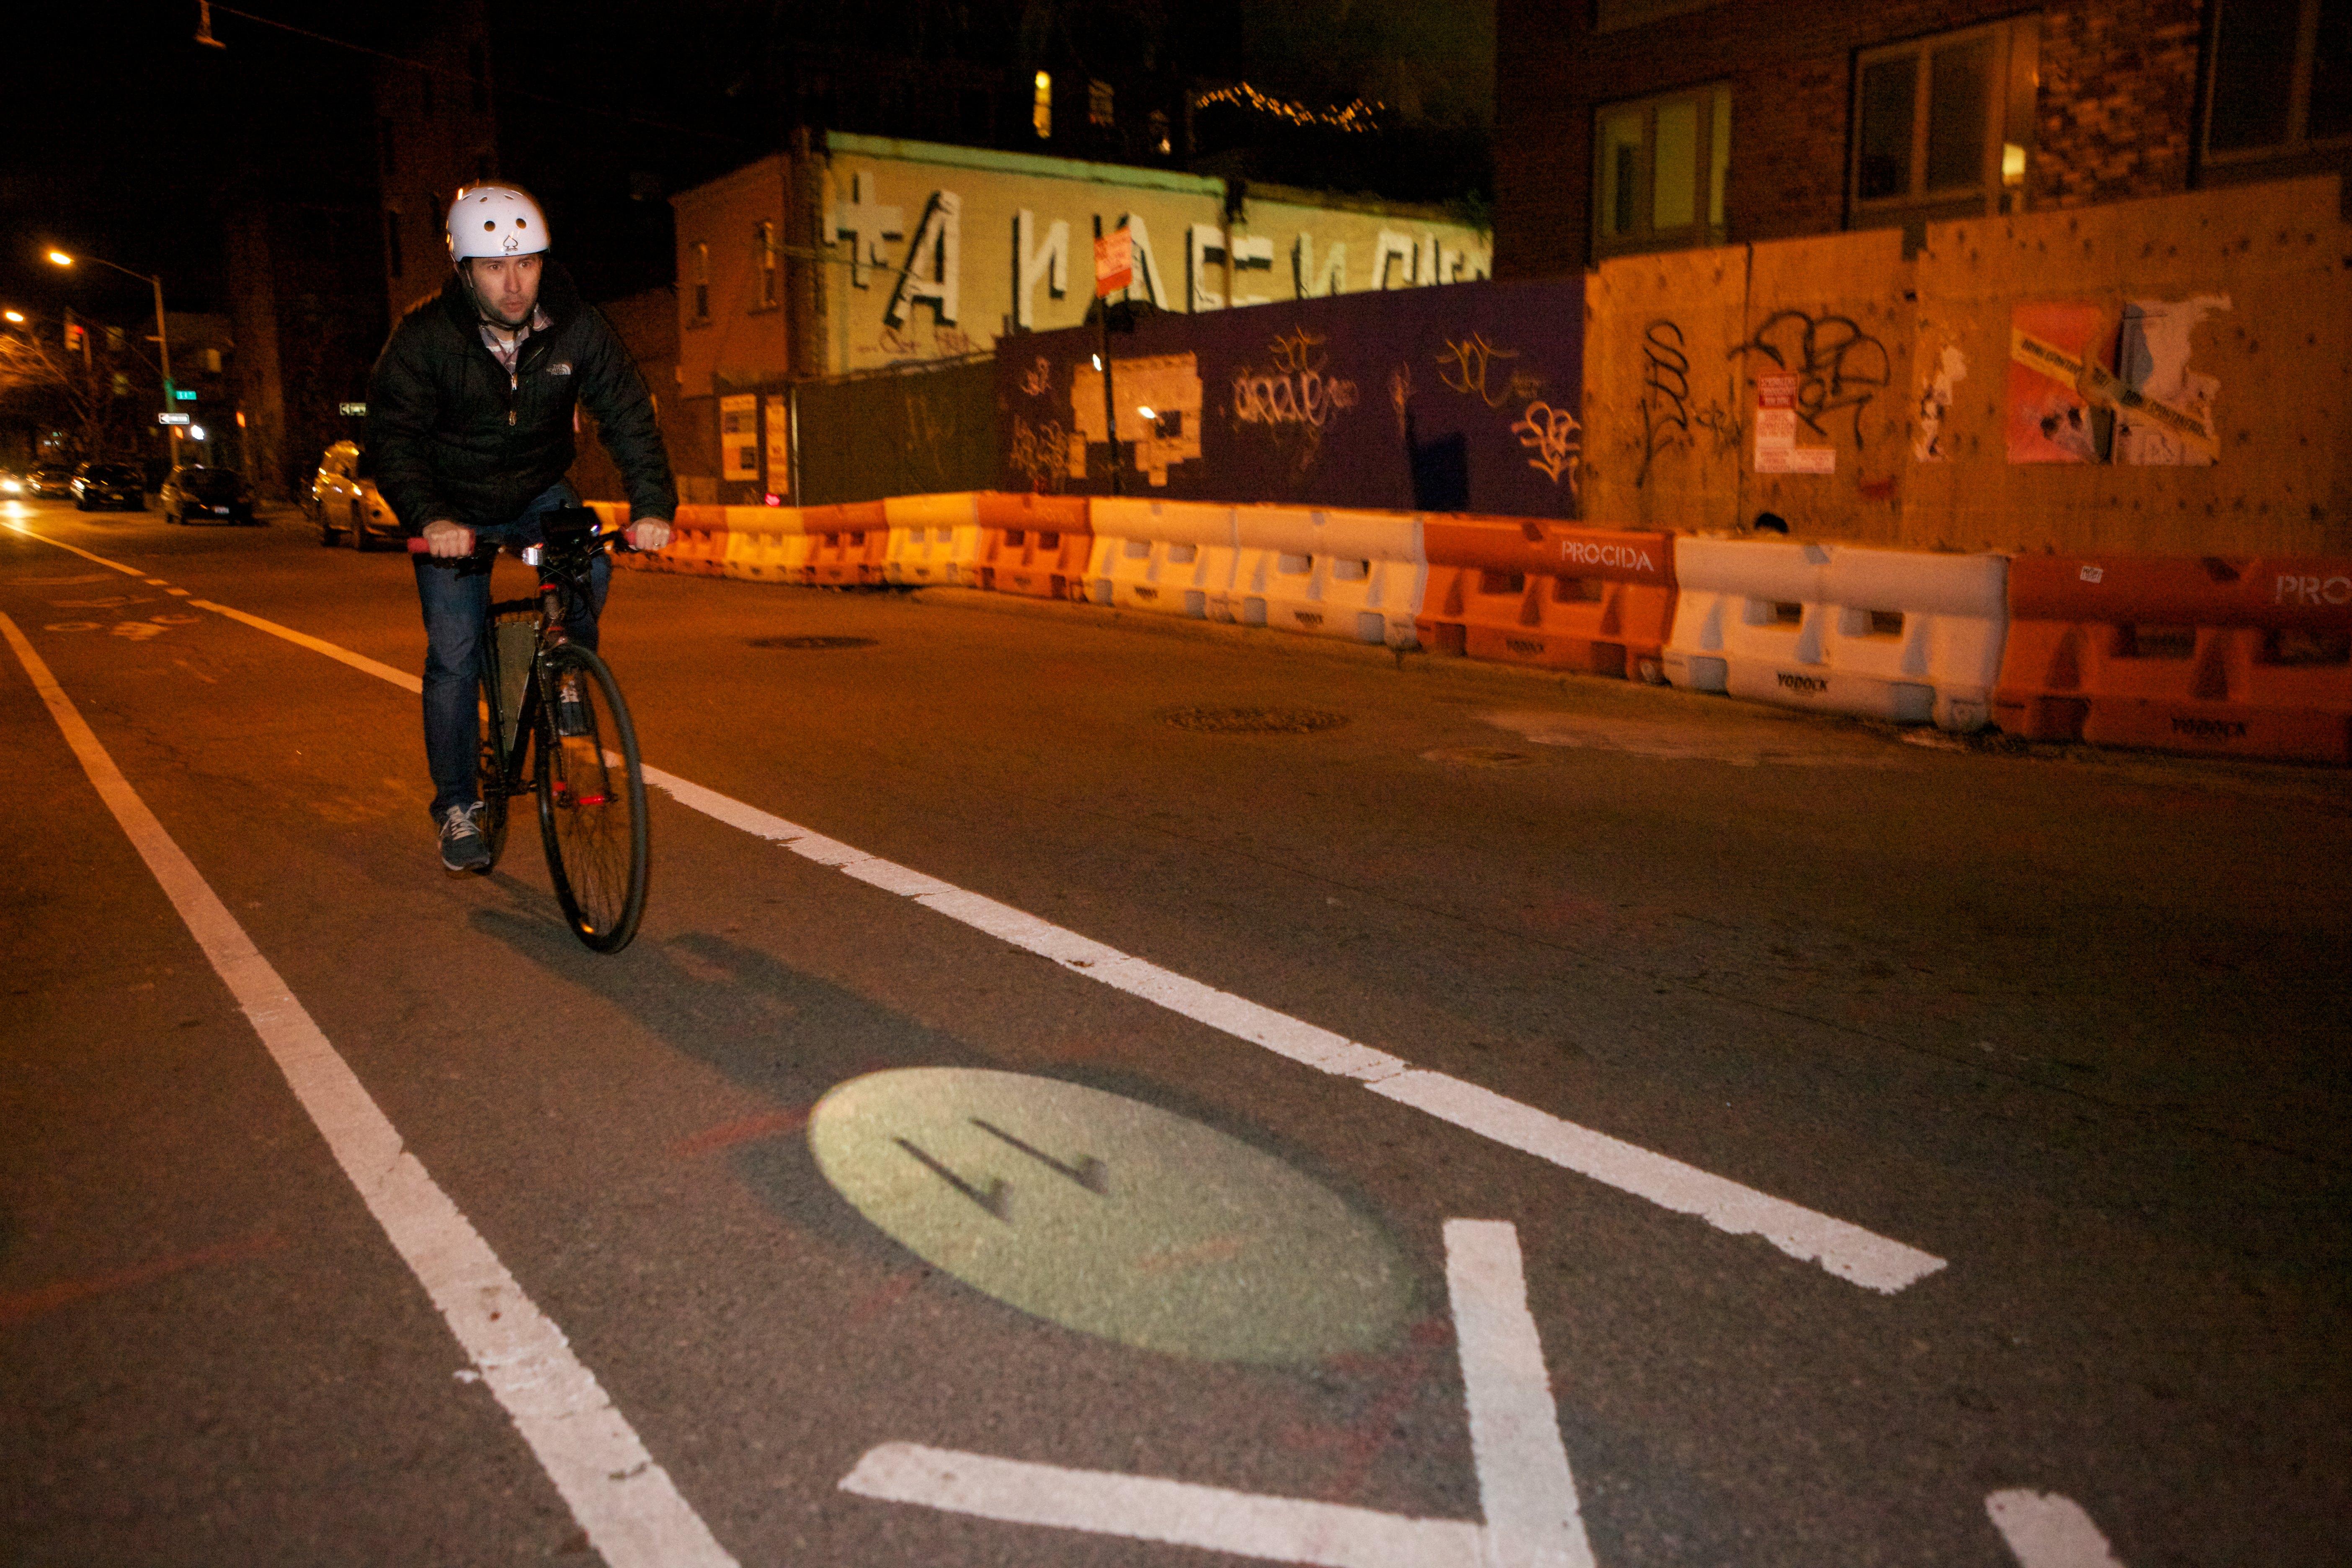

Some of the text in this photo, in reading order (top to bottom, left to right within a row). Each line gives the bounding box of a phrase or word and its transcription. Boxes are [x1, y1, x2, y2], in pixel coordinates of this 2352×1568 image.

[1561, 541, 1655, 572] PROCIDA
[2275, 575, 2352, 604] PRO
[1777, 673, 1829, 692] YODOCK
